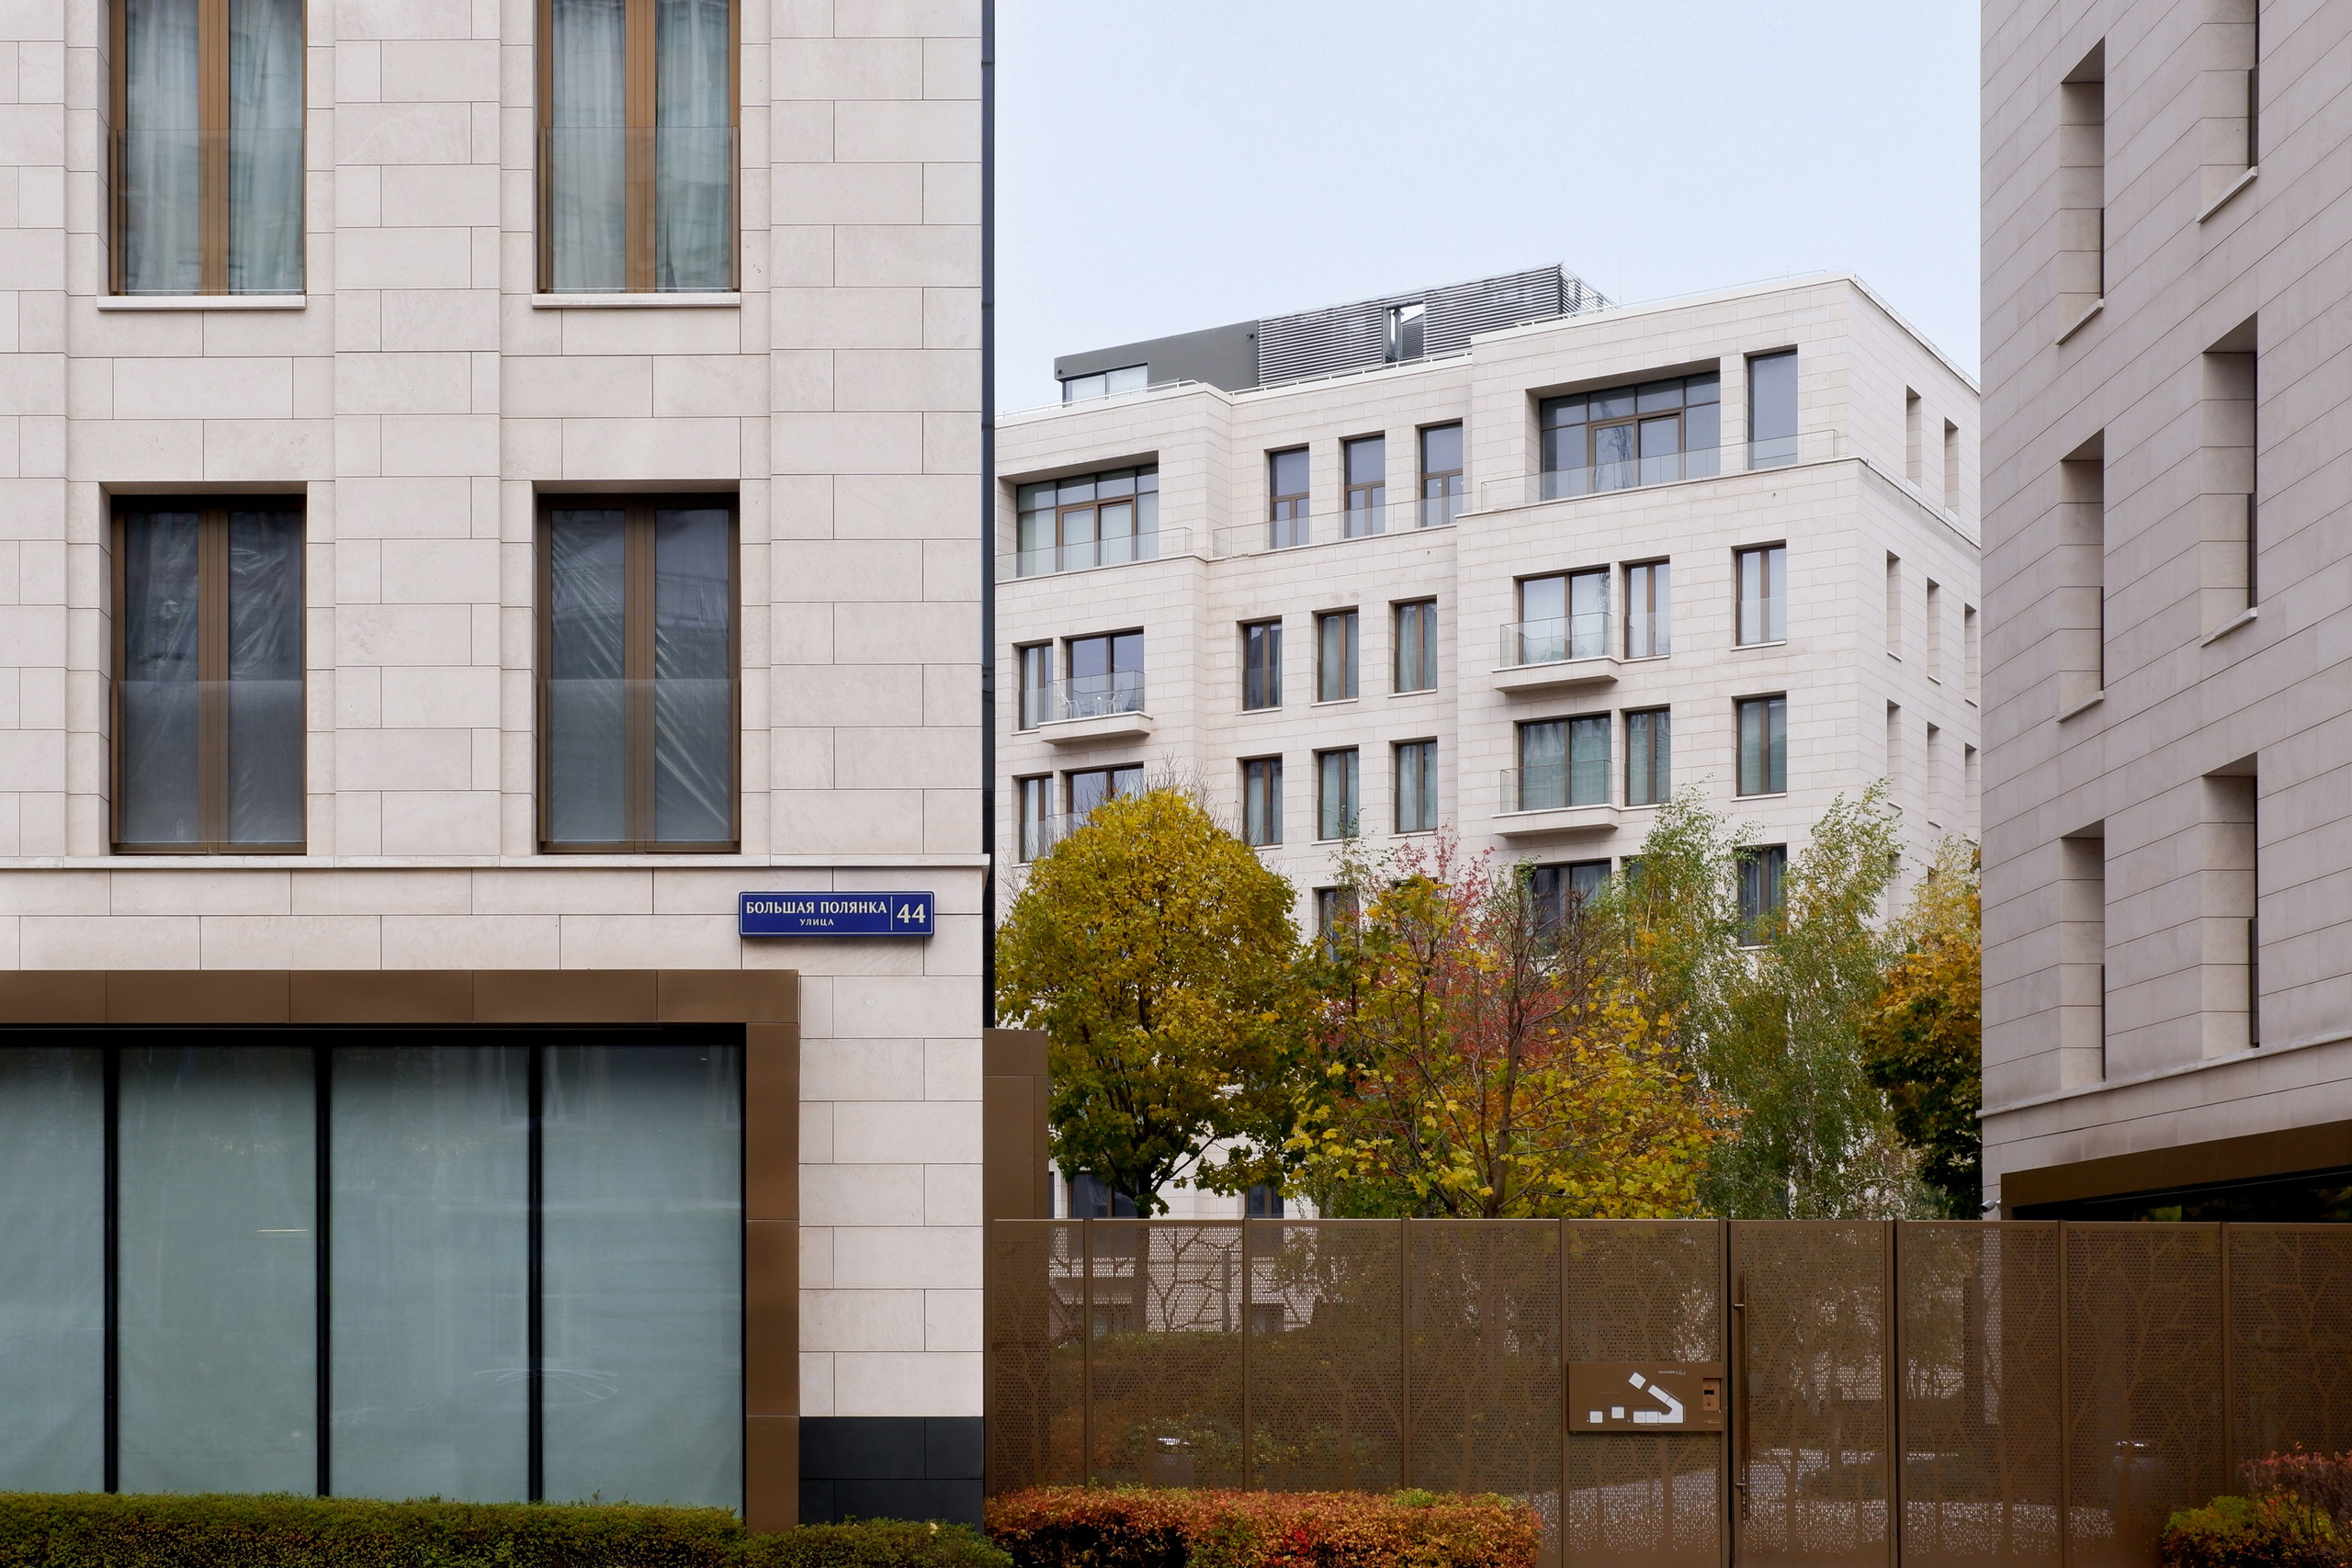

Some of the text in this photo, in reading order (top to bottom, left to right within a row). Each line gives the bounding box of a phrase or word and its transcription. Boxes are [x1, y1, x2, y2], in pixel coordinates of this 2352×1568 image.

[746, 901, 888, 914] БОЛЬШАЯ ПОЛЯНКА
[896, 903, 926, 923] 44
[799, 918, 834, 926] УЛИЦА
